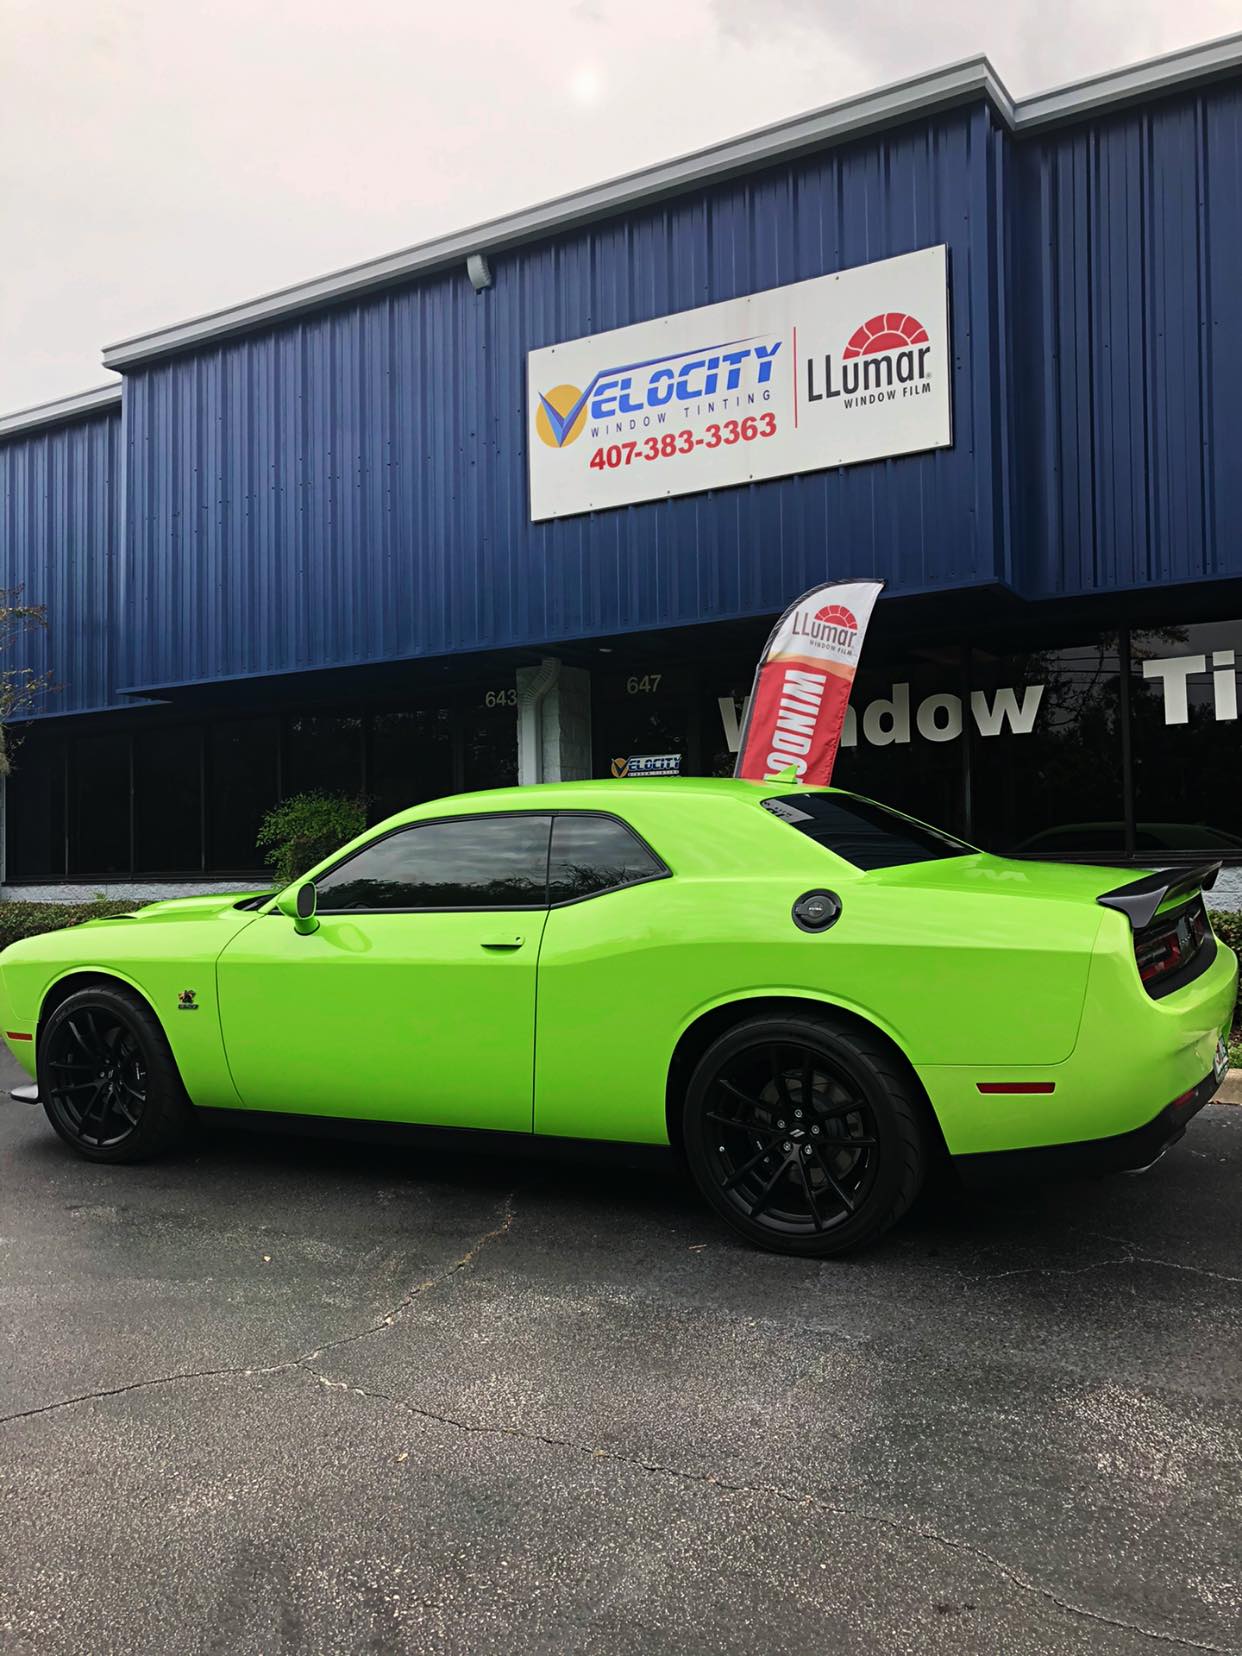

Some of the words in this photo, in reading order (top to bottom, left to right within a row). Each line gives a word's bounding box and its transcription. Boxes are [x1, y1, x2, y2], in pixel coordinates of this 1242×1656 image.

[538, 334, 783, 448] VELOCITY
[807, 346, 931, 403] LLumar
[844, 389, 896, 409] WINDOW
[902, 382, 931, 399] FILM
[591, 412, 667, 438] WINDOW
[684, 390, 772, 418] TINTING
[589, 412, 777, 470] 407-383-3363
[792, 611, 858, 648] LLumar
[485, 691, 517, 708] 643
[626, 674, 662, 695] 647
[763, 669, 827, 784] WINDO
[611, 754, 681, 777] VELOCITY
